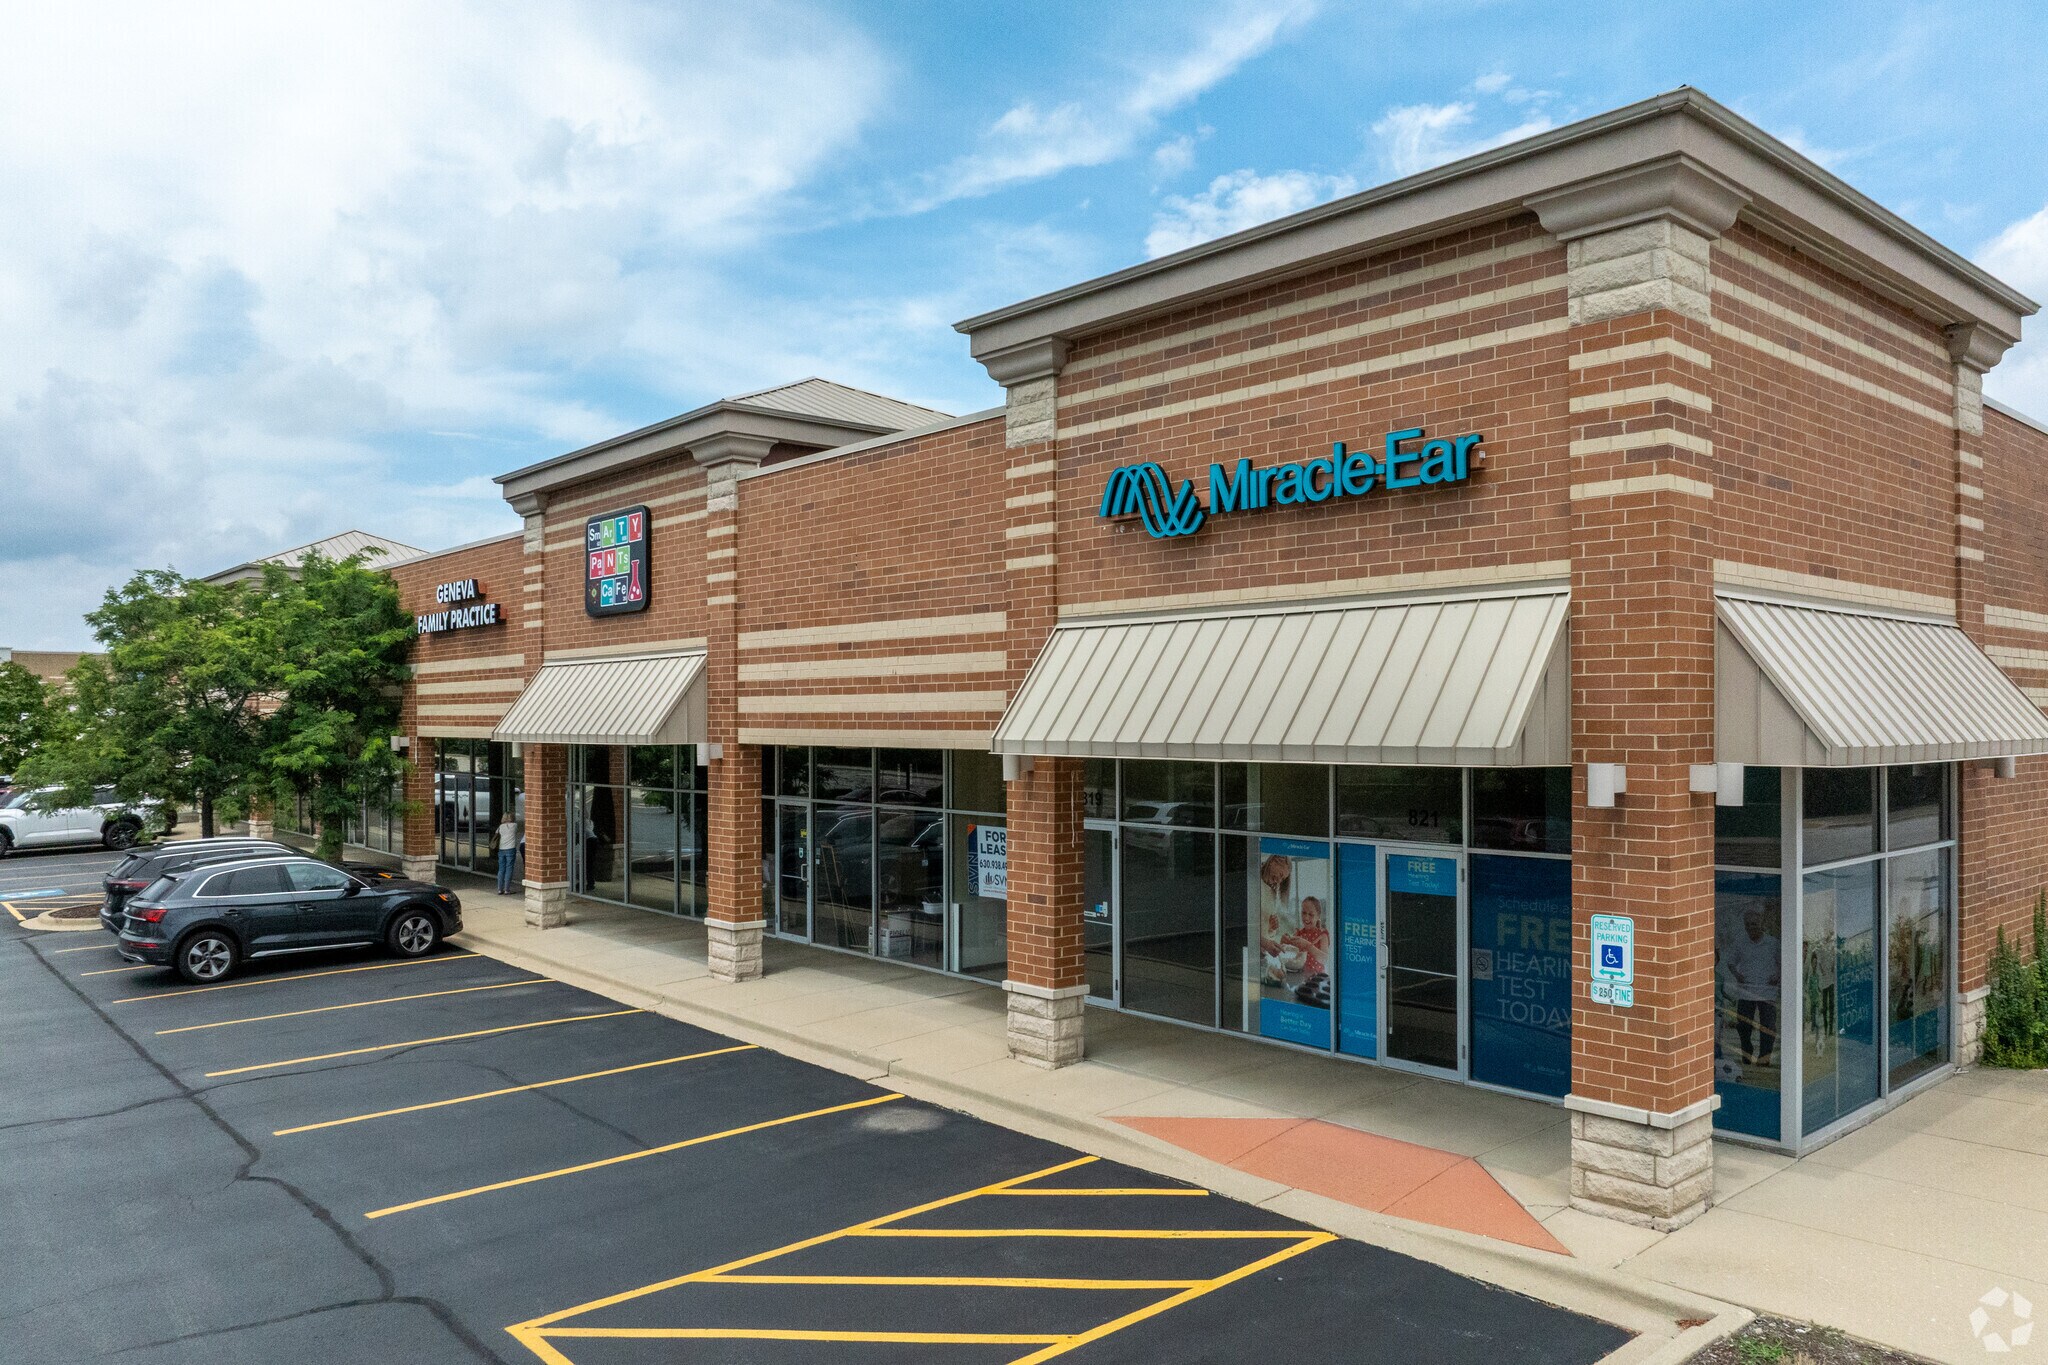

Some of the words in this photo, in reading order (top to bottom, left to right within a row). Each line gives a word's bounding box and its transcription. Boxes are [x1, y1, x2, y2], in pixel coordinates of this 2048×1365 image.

[1209, 427, 1484, 515] Miracle-Ear
[436, 578, 475, 604] GENEVA
[417, 610, 449, 635] FAMILY
[450, 603, 496, 630] PRACTICE
[1408, 809, 1438, 828] 821
[985, 830, 1006, 843] FOR
[980, 843, 1006, 856] LEAS
[1408, 860, 1436, 874] FREE
[1344, 922, 1376, 938] FREE
[1496, 912, 1571, 954] FRE
[1594, 921, 1631, 933] RESERVED
[1596, 932, 1628, 944] PARKING
[1345, 943, 1362, 954] TEST
[1496, 950, 1571, 979] HEARIN
[1497, 974, 1553, 1000] TEST
[1614, 988, 1632, 1002] FINE
